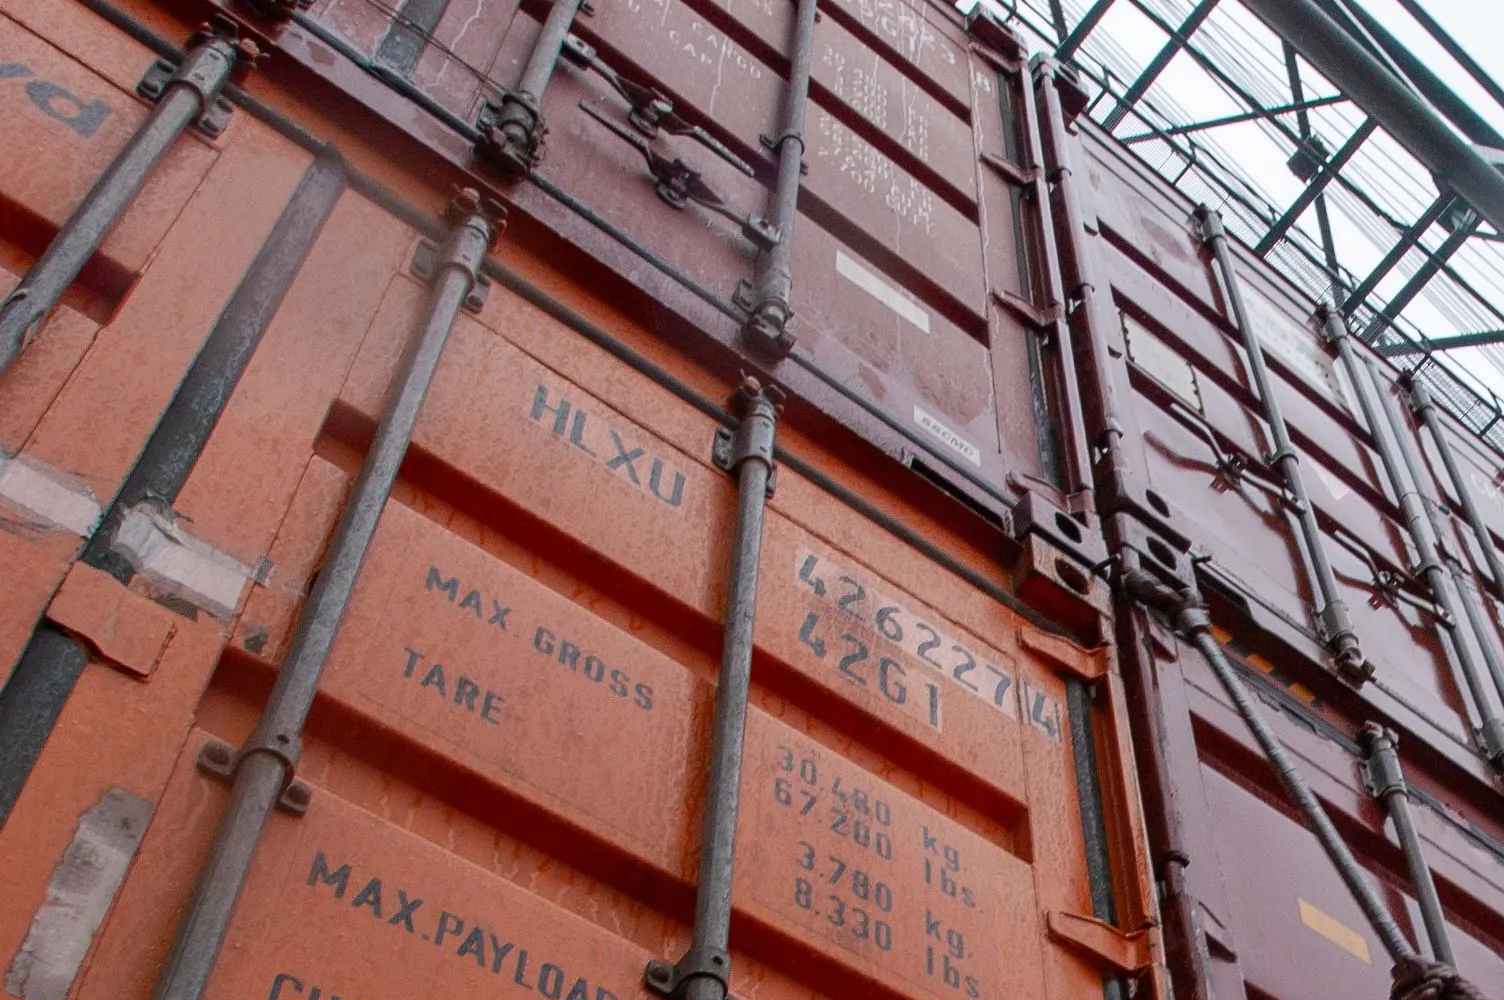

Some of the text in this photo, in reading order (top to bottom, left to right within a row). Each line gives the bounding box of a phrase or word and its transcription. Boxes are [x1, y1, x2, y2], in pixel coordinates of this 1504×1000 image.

[530, 384, 686, 507] HLXU
[404, 647, 506, 726] TARE
[533, 626, 655, 711] GROSS
[798, 611, 940, 728] 42G1
[774, 777, 893, 860] 67.200
[794, 877, 893, 952] 8.330
[795, 841, 893, 913] 3.780
